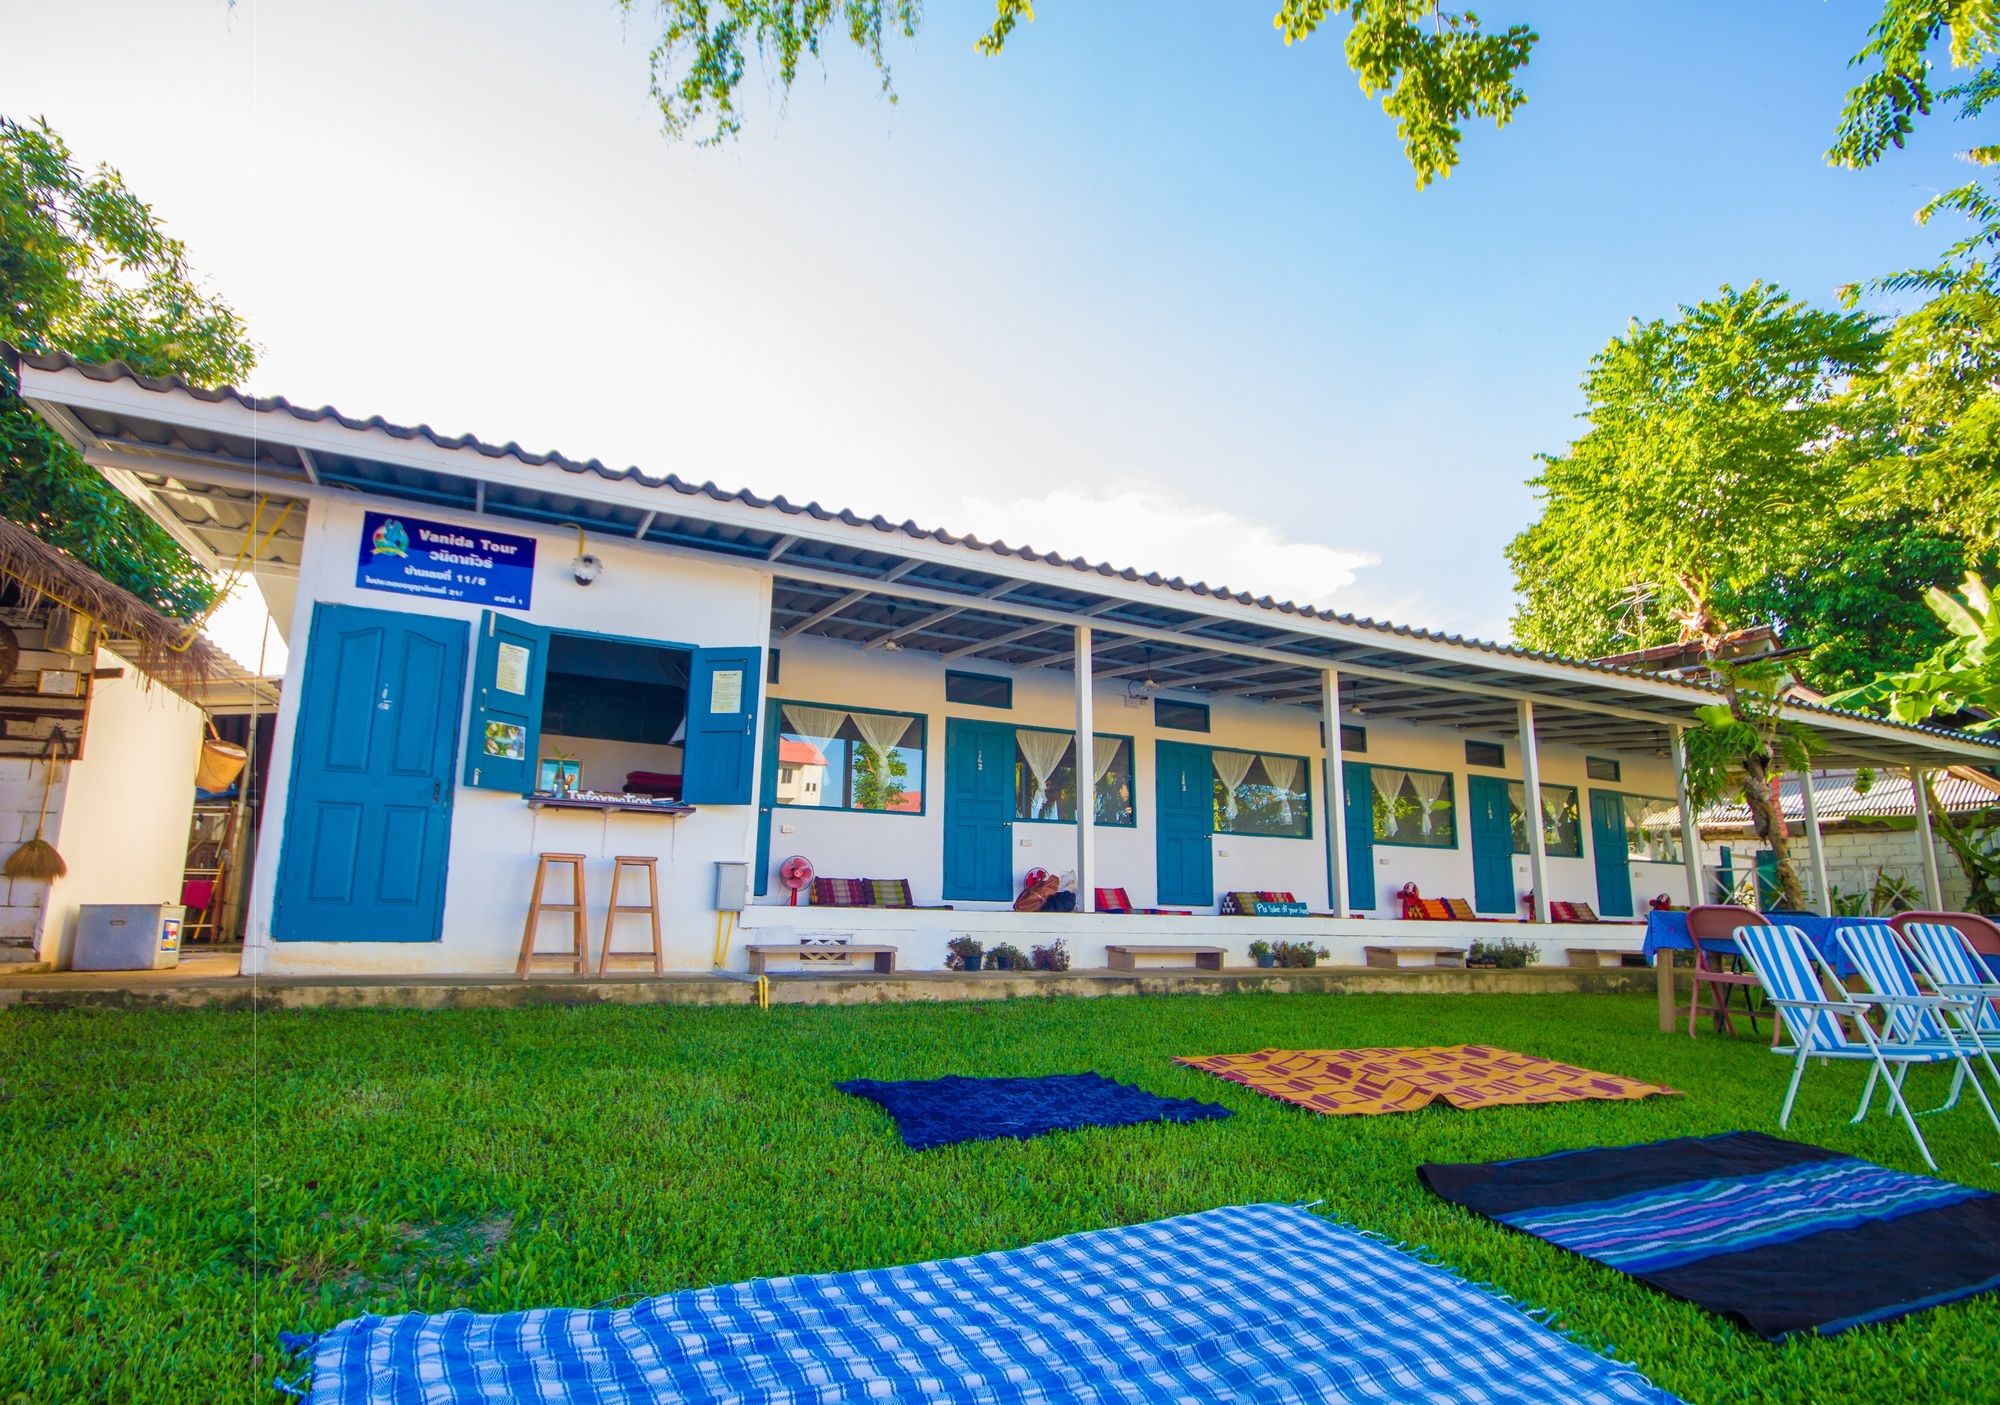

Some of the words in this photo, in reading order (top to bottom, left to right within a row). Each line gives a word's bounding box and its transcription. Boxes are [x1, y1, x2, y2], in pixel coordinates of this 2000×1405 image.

[419, 529, 474, 549] Vanida
[480, 539, 518, 555] Tour
[429, 549, 494, 569] วนิดาทัวร์
[404, 566, 452, 581] บ้านเลขที่
[567, 789, 654, 805] Information
[1256, 903, 1268, 913] Pls
